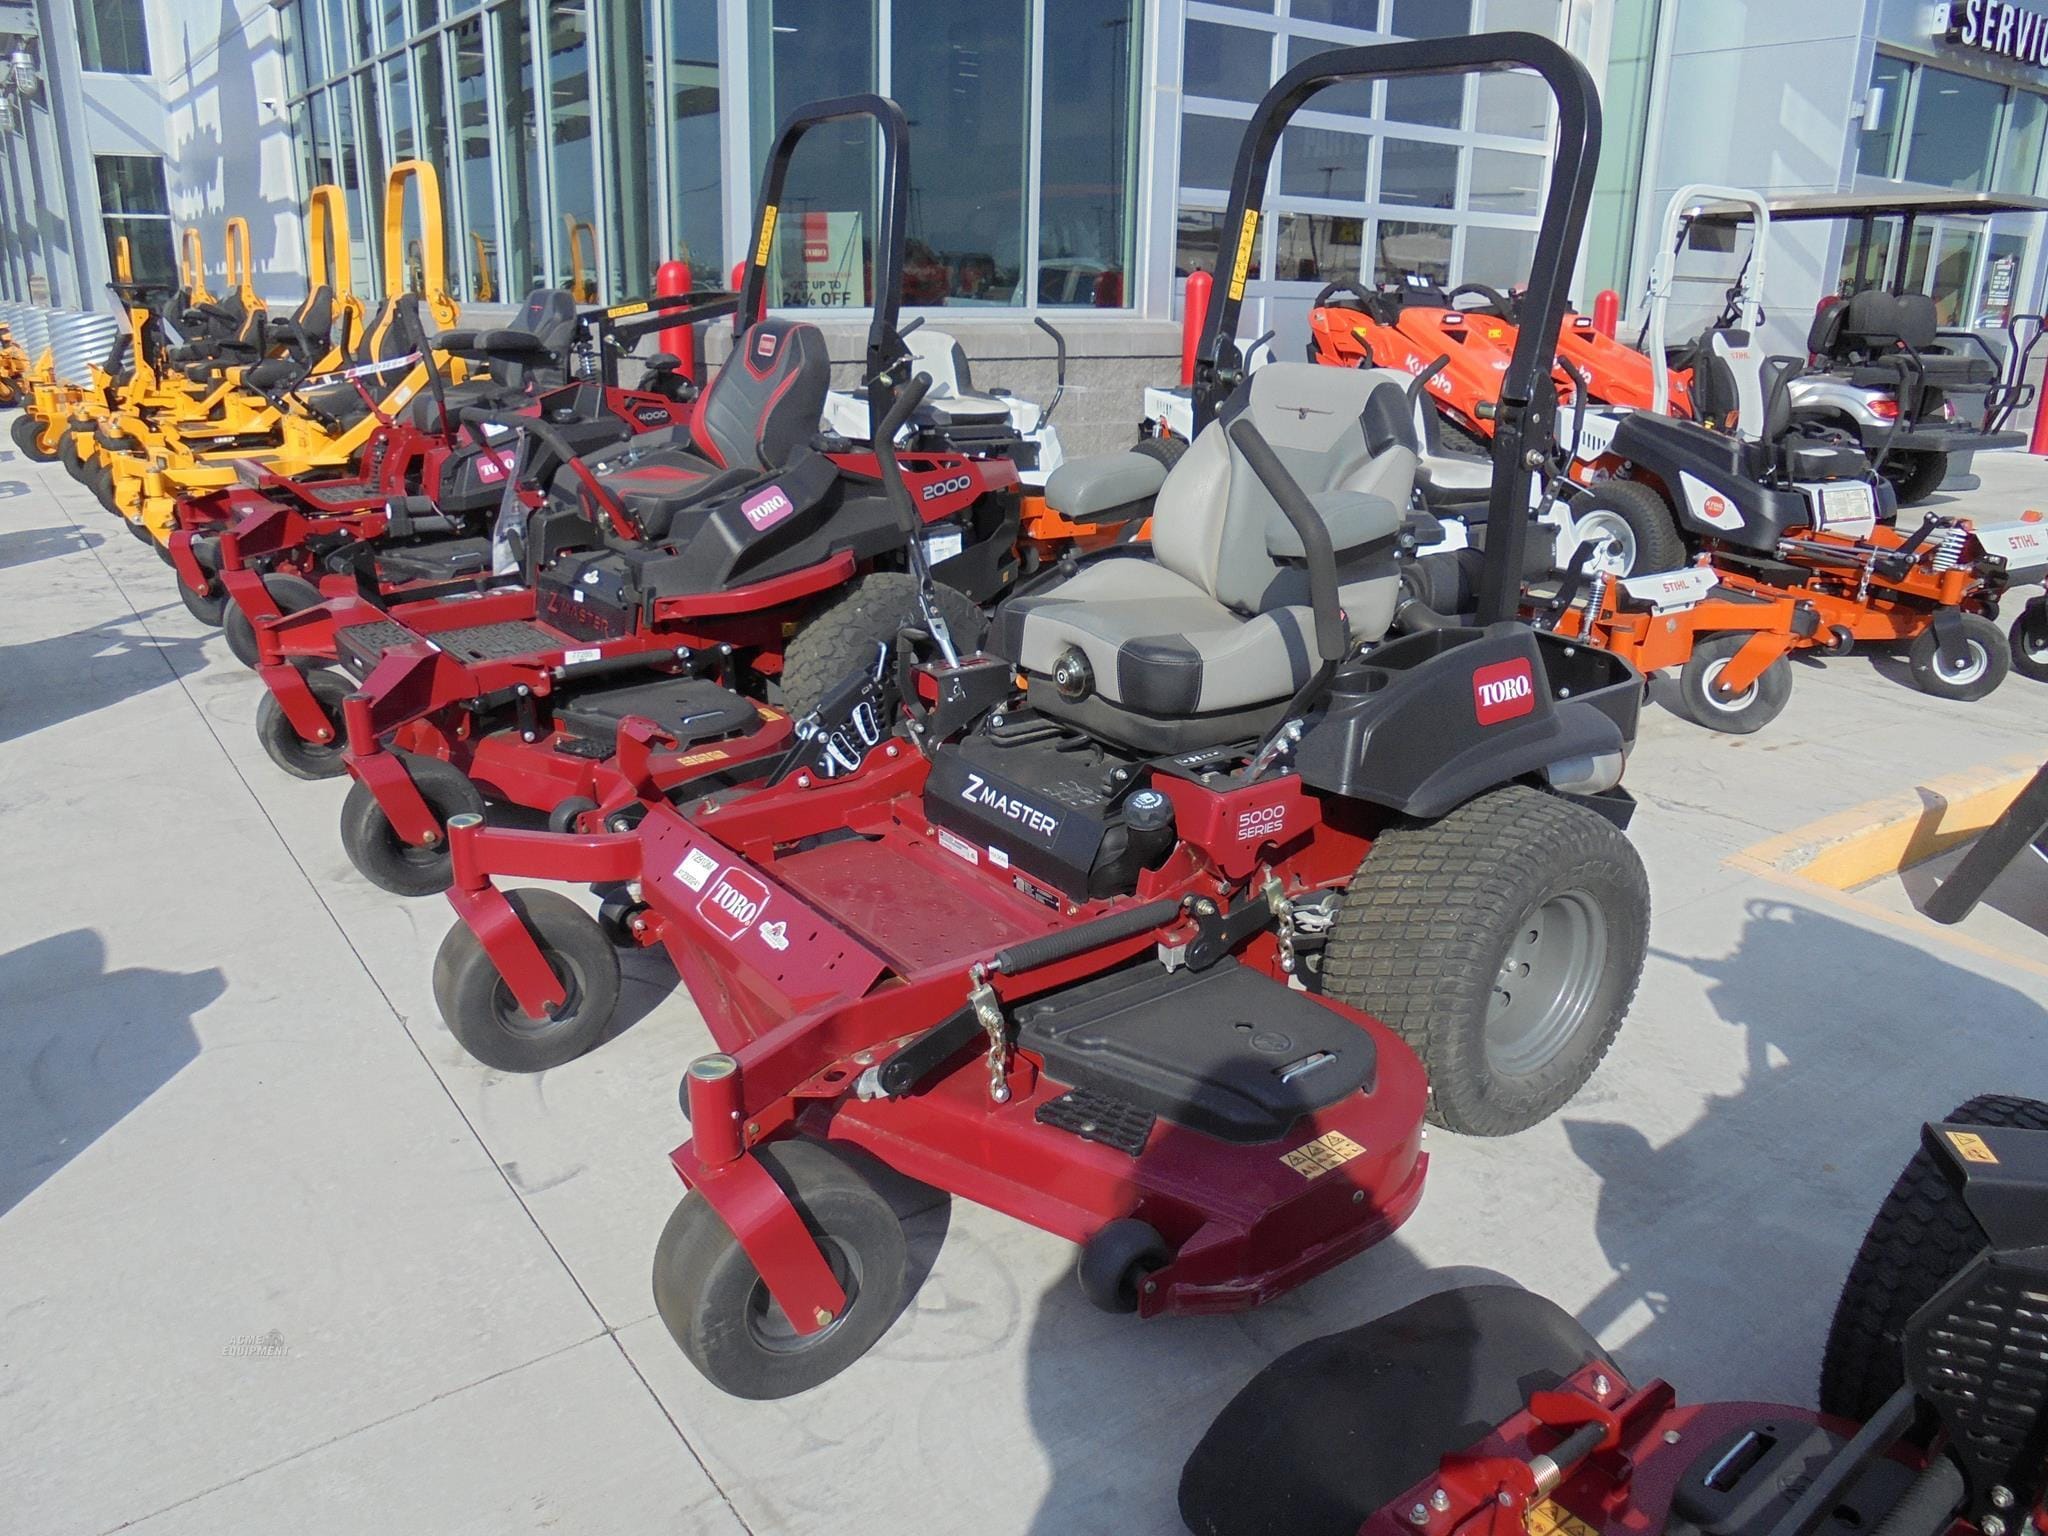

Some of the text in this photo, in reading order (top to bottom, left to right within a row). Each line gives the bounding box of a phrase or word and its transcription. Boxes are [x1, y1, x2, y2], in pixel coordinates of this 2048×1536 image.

[812, 281, 826, 289] UP
[829, 281, 841, 289] TO
[821, 292, 851, 306] OFF
[639, 410, 668, 420] 4000
[922, 475, 972, 501] 2000
[748, 495, 785, 522] TORO
[2008, 534, 2039, 549] STIHL
[1663, 580, 1690, 592] STIHL
[1478, 675, 1529, 707] TORO
[1239, 805, 1285, 827] 5000
[1238, 820, 1283, 840] SERIES
[712, 881, 756, 922] TORO
